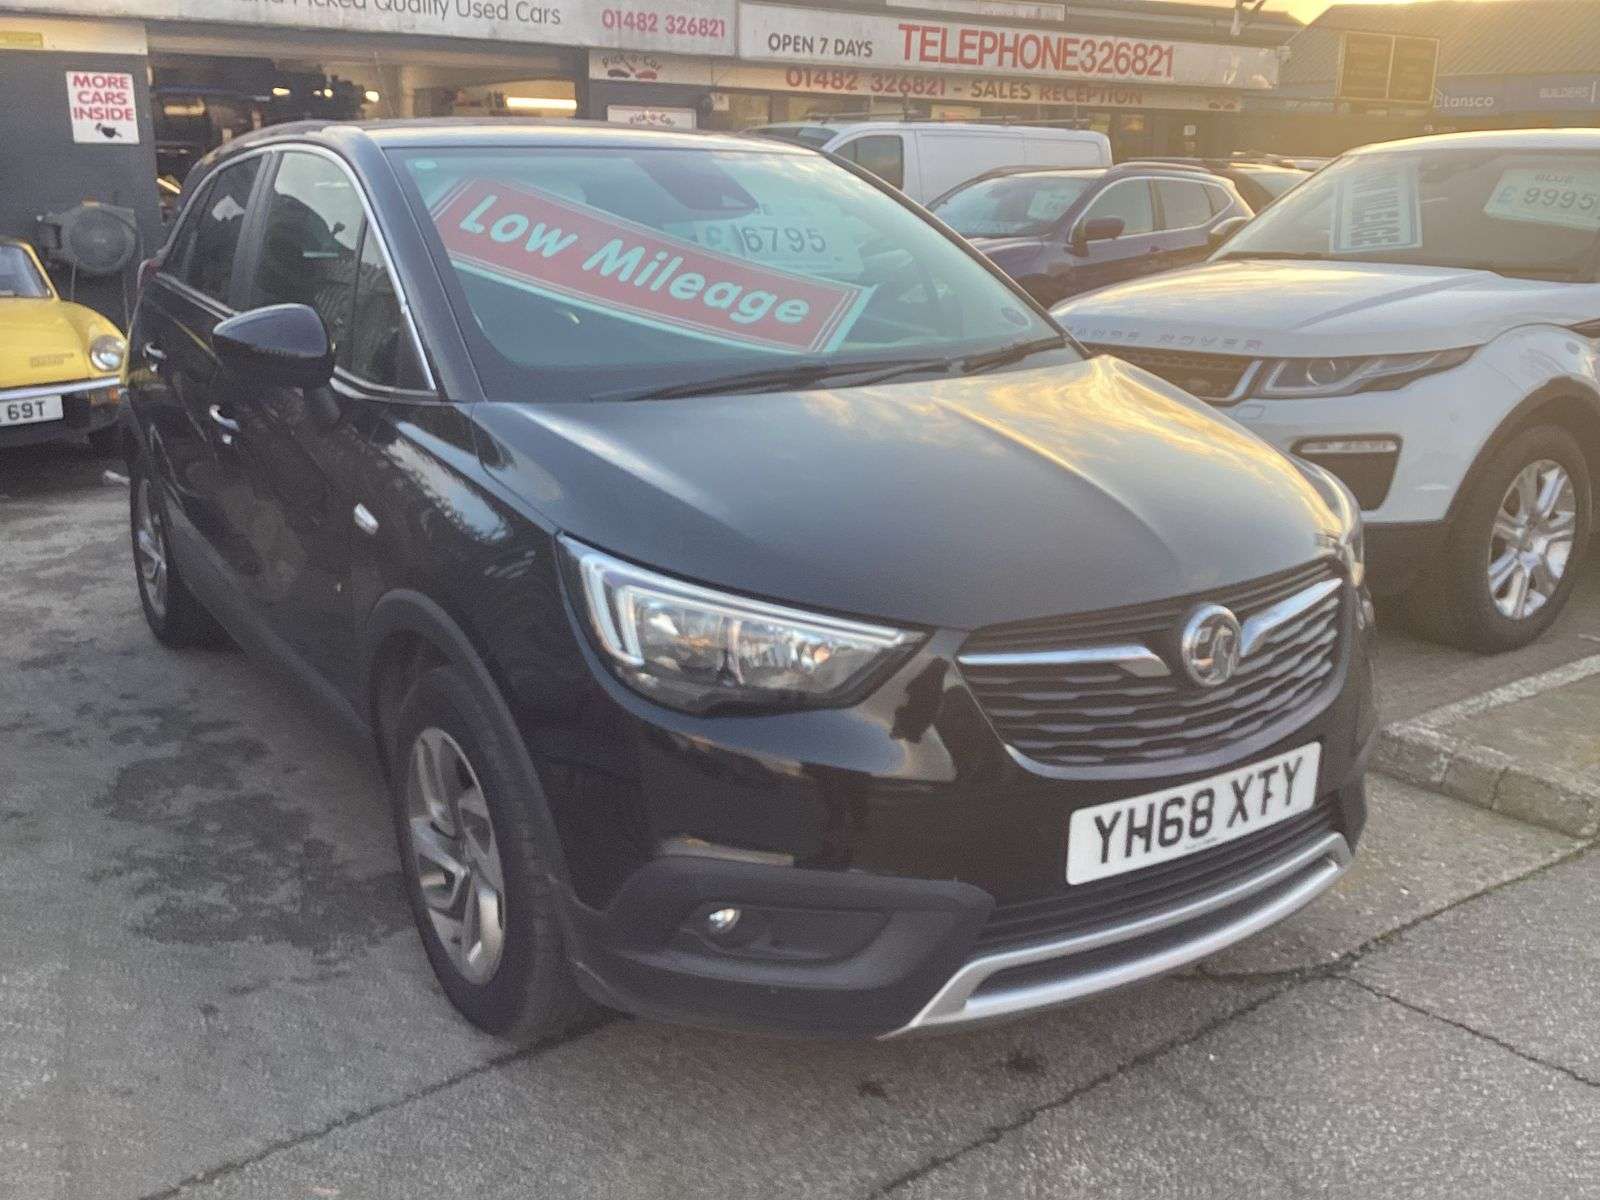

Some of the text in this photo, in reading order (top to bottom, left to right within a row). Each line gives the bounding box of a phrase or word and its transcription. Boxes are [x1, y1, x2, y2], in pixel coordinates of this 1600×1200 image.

[375, 0, 450, 21] Quality
[455, 0, 509, 20] Used
[516, 1, 561, 25] Cars
[602, 9, 725, 38] 01482 326821
[768, 33, 873, 58] OPEN 7 DAYS
[73, 75, 129, 89] MORE
[785, 66, 858, 91] 01482
[870, 72, 946, 96] 326821
[970, 79, 1032, 100] SALES
[1039, 83, 1143, 105] RECEPTION
[77, 91, 127, 105] CARS
[73, 107, 134, 121] INSIDE
[1523, 187, 1596, 210] 9995
[458, 194, 810, 324] Low Mileage
[7, 400, 46, 420] 69T
[1094, 757, 1303, 864] YH68 XTY
